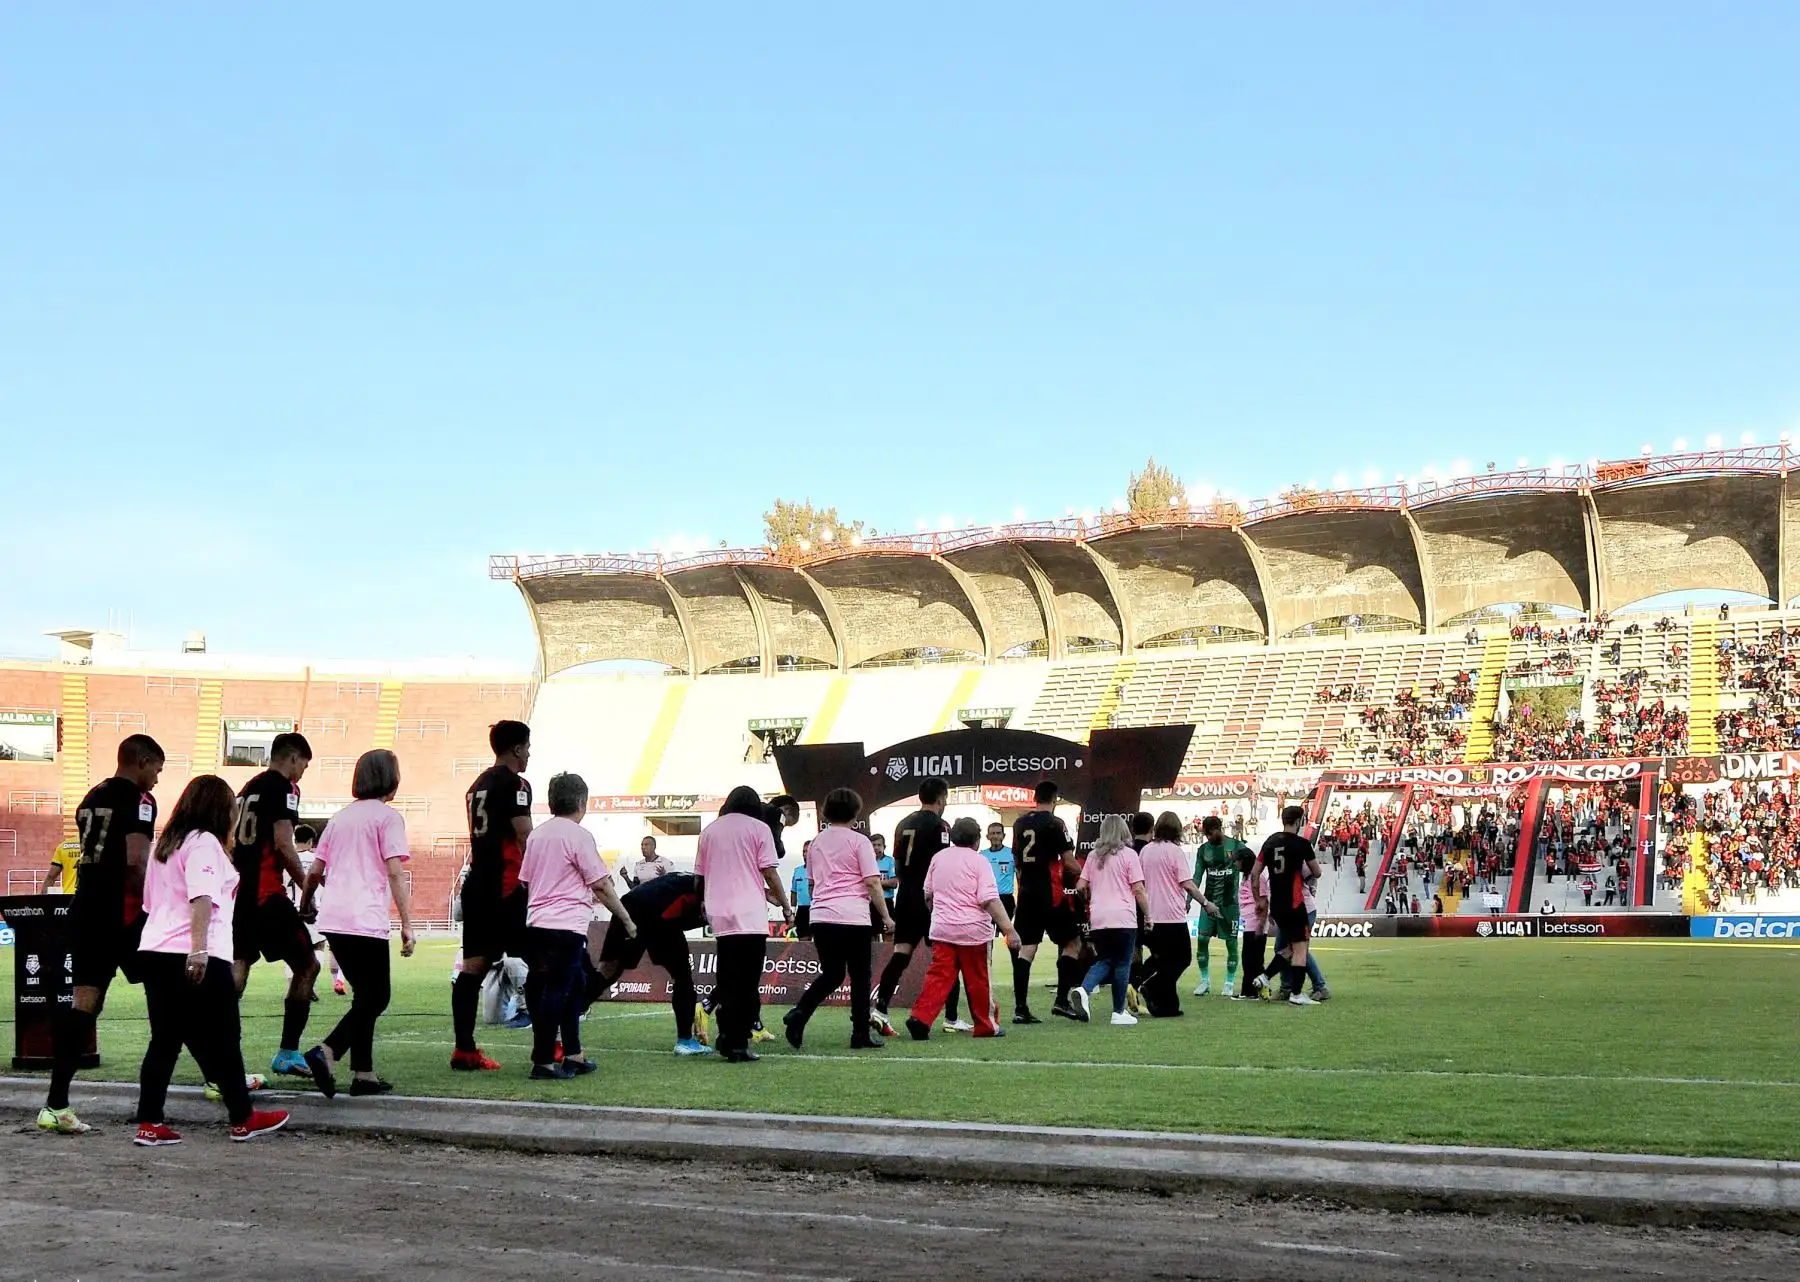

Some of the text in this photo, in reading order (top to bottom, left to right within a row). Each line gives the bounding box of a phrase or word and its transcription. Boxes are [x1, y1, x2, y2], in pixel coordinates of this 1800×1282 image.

[1520, 675, 1564, 687] SALIDA
[913, 755, 1067, 777] LIGA1 betsson
[1676, 758, 1712, 770] STA.
[1670, 769, 1718, 782] ROSA
[1176, 780, 1248, 797] DOMINO
[79, 807, 113, 864] 27
[902, 829, 916, 866] 7
[1023, 829, 1036, 863] 2
[1274, 847, 1285, 874] 5
[4, 905, 45, 916] marathon
[1311, 920, 1373, 938] tinbet
[1496, 921, 1605, 935] LIGA1 betsson
[1714, 917, 1800, 938] betcr
[762, 956, 824, 974] betss
[619, 982, 652, 994] SPORADE
[758, 984, 787, 995] athon
[20, 994, 46, 1003] betsson
[57, 994, 74, 1003] bets
